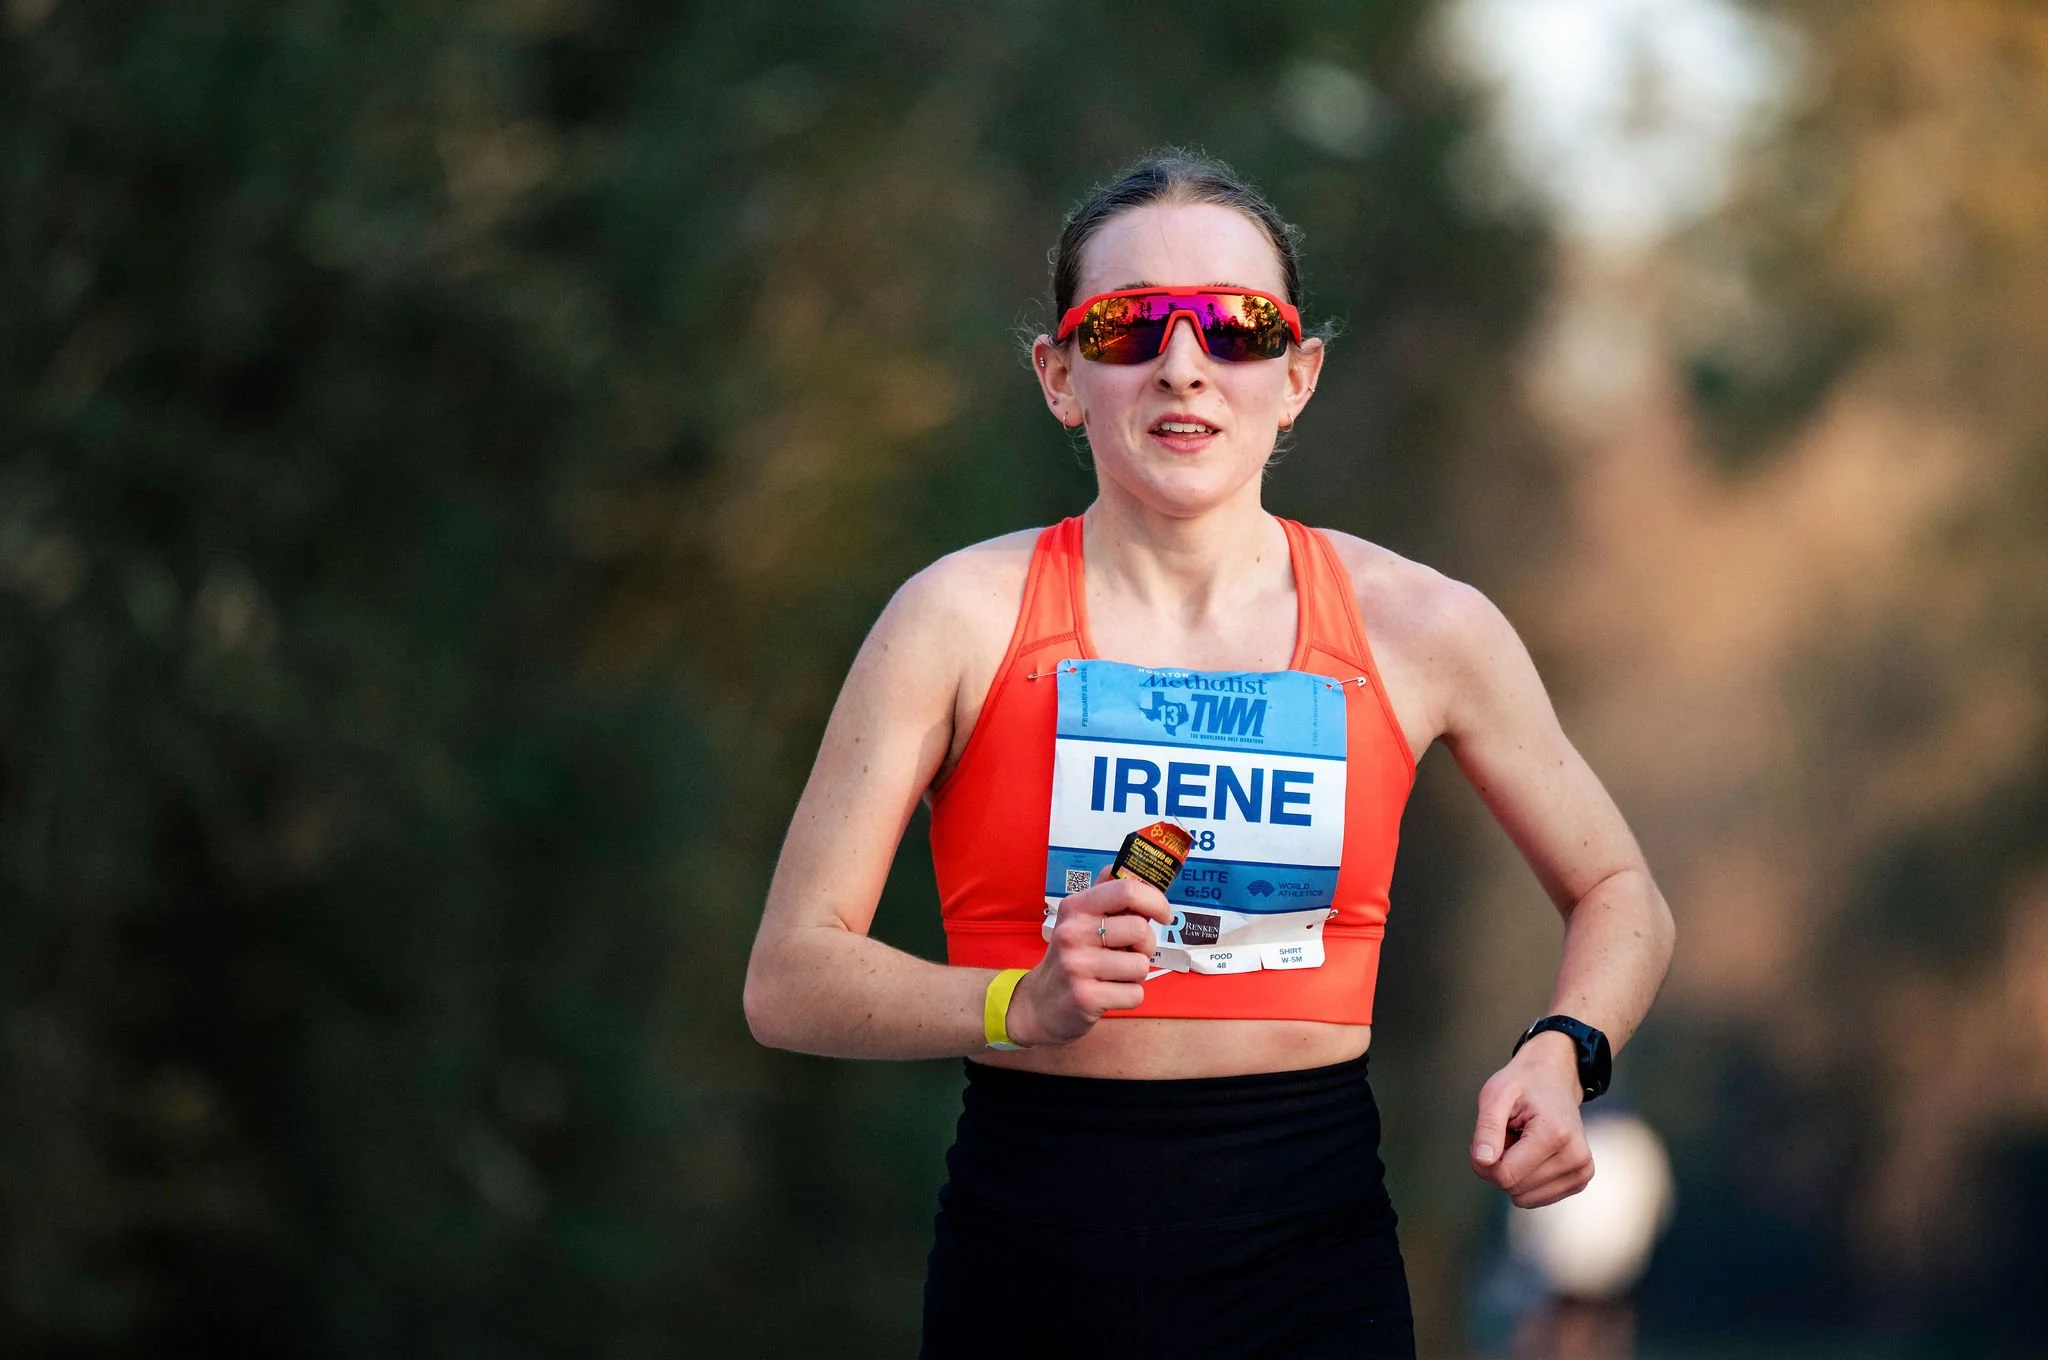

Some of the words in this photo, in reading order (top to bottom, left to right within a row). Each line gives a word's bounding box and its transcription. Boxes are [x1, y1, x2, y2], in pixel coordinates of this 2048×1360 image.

[1138, 668, 1189, 679] HOUSTON
[1139, 674, 1268, 695] Methodist
[1191, 693, 1267, 738] TWM
[1090, 755, 1315, 827] IRENE
[1134, 837, 1166, 861] CAFFEINATED
[1181, 868, 1229, 884] ELITE
[1278, 882, 1311, 890] WORLD
[1184, 886, 1223, 900] 6:50
[1277, 889, 1324, 898] ATHLETICS
[1185, 922, 1219, 933] RENKEN
[1201, 931, 1218, 939] FIRM
[1209, 952, 1233, 961] FOOD
[1279, 947, 1303, 955] SHIRT
[1281, 956, 1303, 964] W-SM
